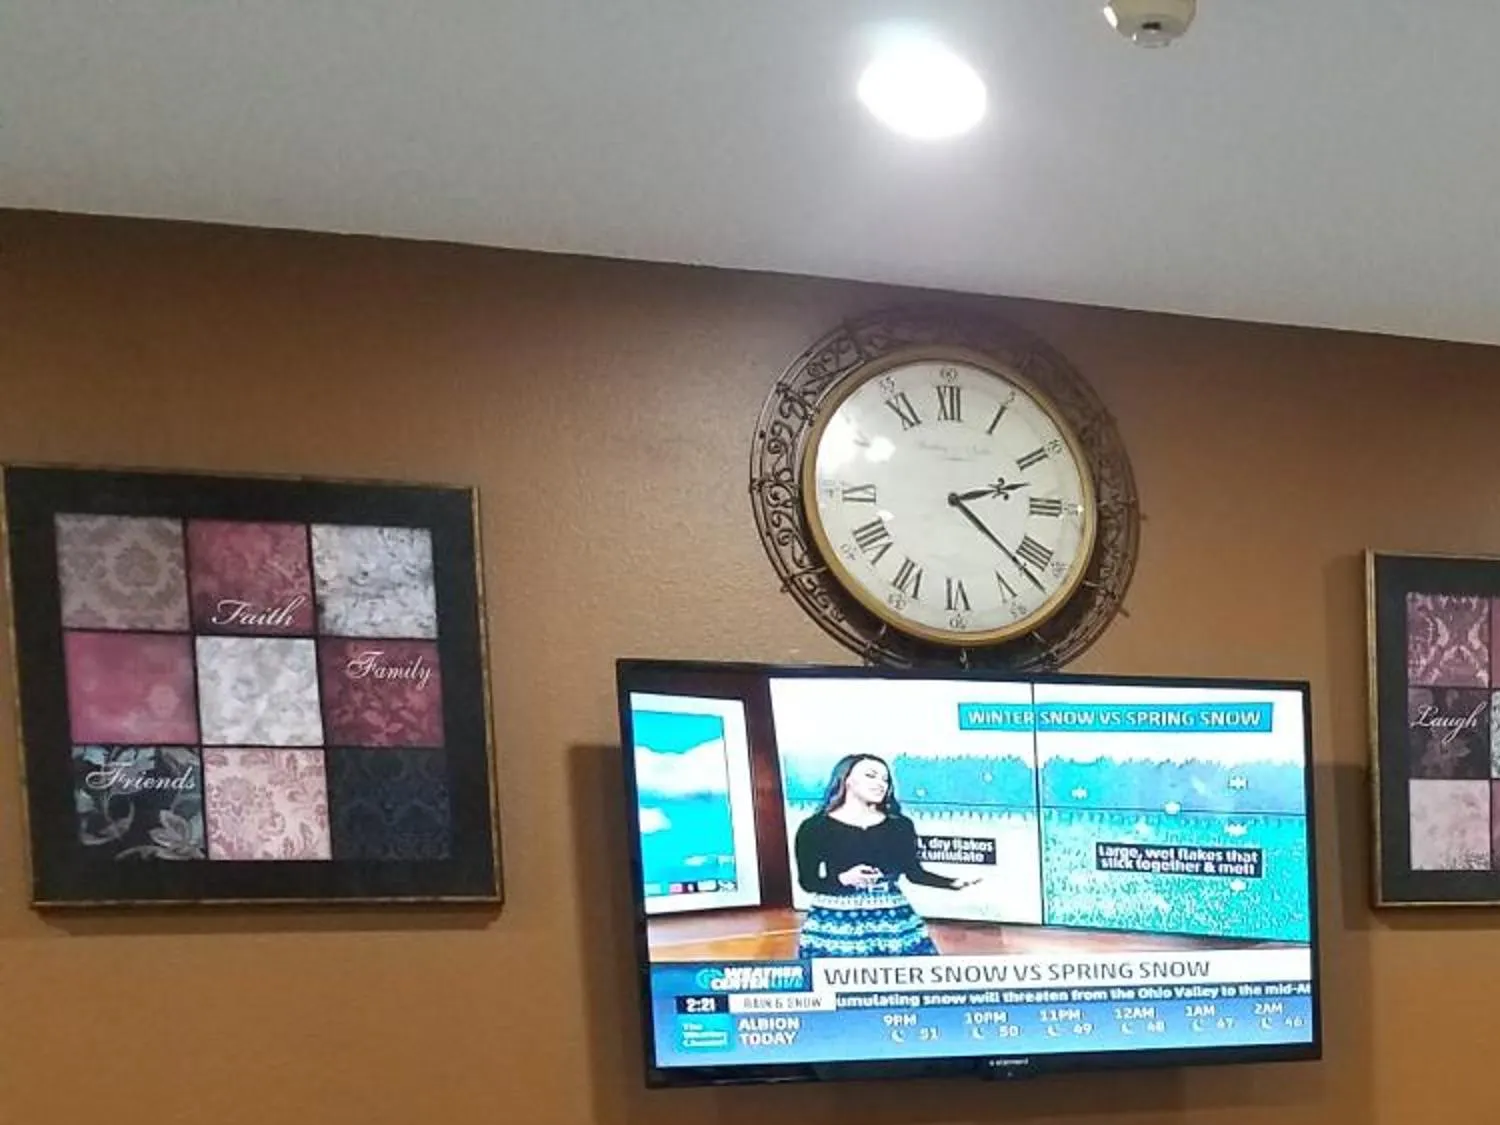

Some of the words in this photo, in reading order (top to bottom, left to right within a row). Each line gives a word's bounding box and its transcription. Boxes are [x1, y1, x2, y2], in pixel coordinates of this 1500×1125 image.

[212, 596, 306, 628] Faith
[345, 650, 433, 688] Family
[968, 710, 1034, 725] WINTER
[1040, 711, 1094, 726] SNOW
[1099, 712, 1121, 726] VS
[1126, 711, 1194, 726] SPRING
[1201, 711, 1261, 726] SNOW
[1409, 702, 1487, 743] Laugh
[85, 762, 197, 792] Friends
[1136, 857, 1200, 873] together
[824, 966, 924, 985] WINTER
[931, 965, 1007, 983] SNOW
[1013, 965, 1042, 981] VS
[1049, 962, 1133, 981] SPRING
[1140, 960, 1210, 978] SNOW
[922, 994, 966, 1005] snow
[969, 991, 999, 1003] will
[1002, 990, 1068, 1003] threaten
[1071, 989, 1107, 1001] from
[1110, 988, 1135, 1000] the
[1138, 986, 1172, 999] Ohio
[1175, 986, 1218, 999] Valley
[1221, 984, 1236, 996] to
[1239, 984, 1262, 996] the
[686, 998, 715, 1012] 2:21
[1185, 1005, 1215, 1017] 1AM
[1254, 1003, 1282, 1015] 2AM
[883, 1014, 917, 1026] 9PM
[965, 1012, 1007, 1024] 10PM
[1040, 1009, 1081, 1021] 11PM
[1114, 1008, 1154, 1020] 12AM
[739, 1018, 799, 1031] ALBION
[740, 1032, 796, 1045] TODAY
